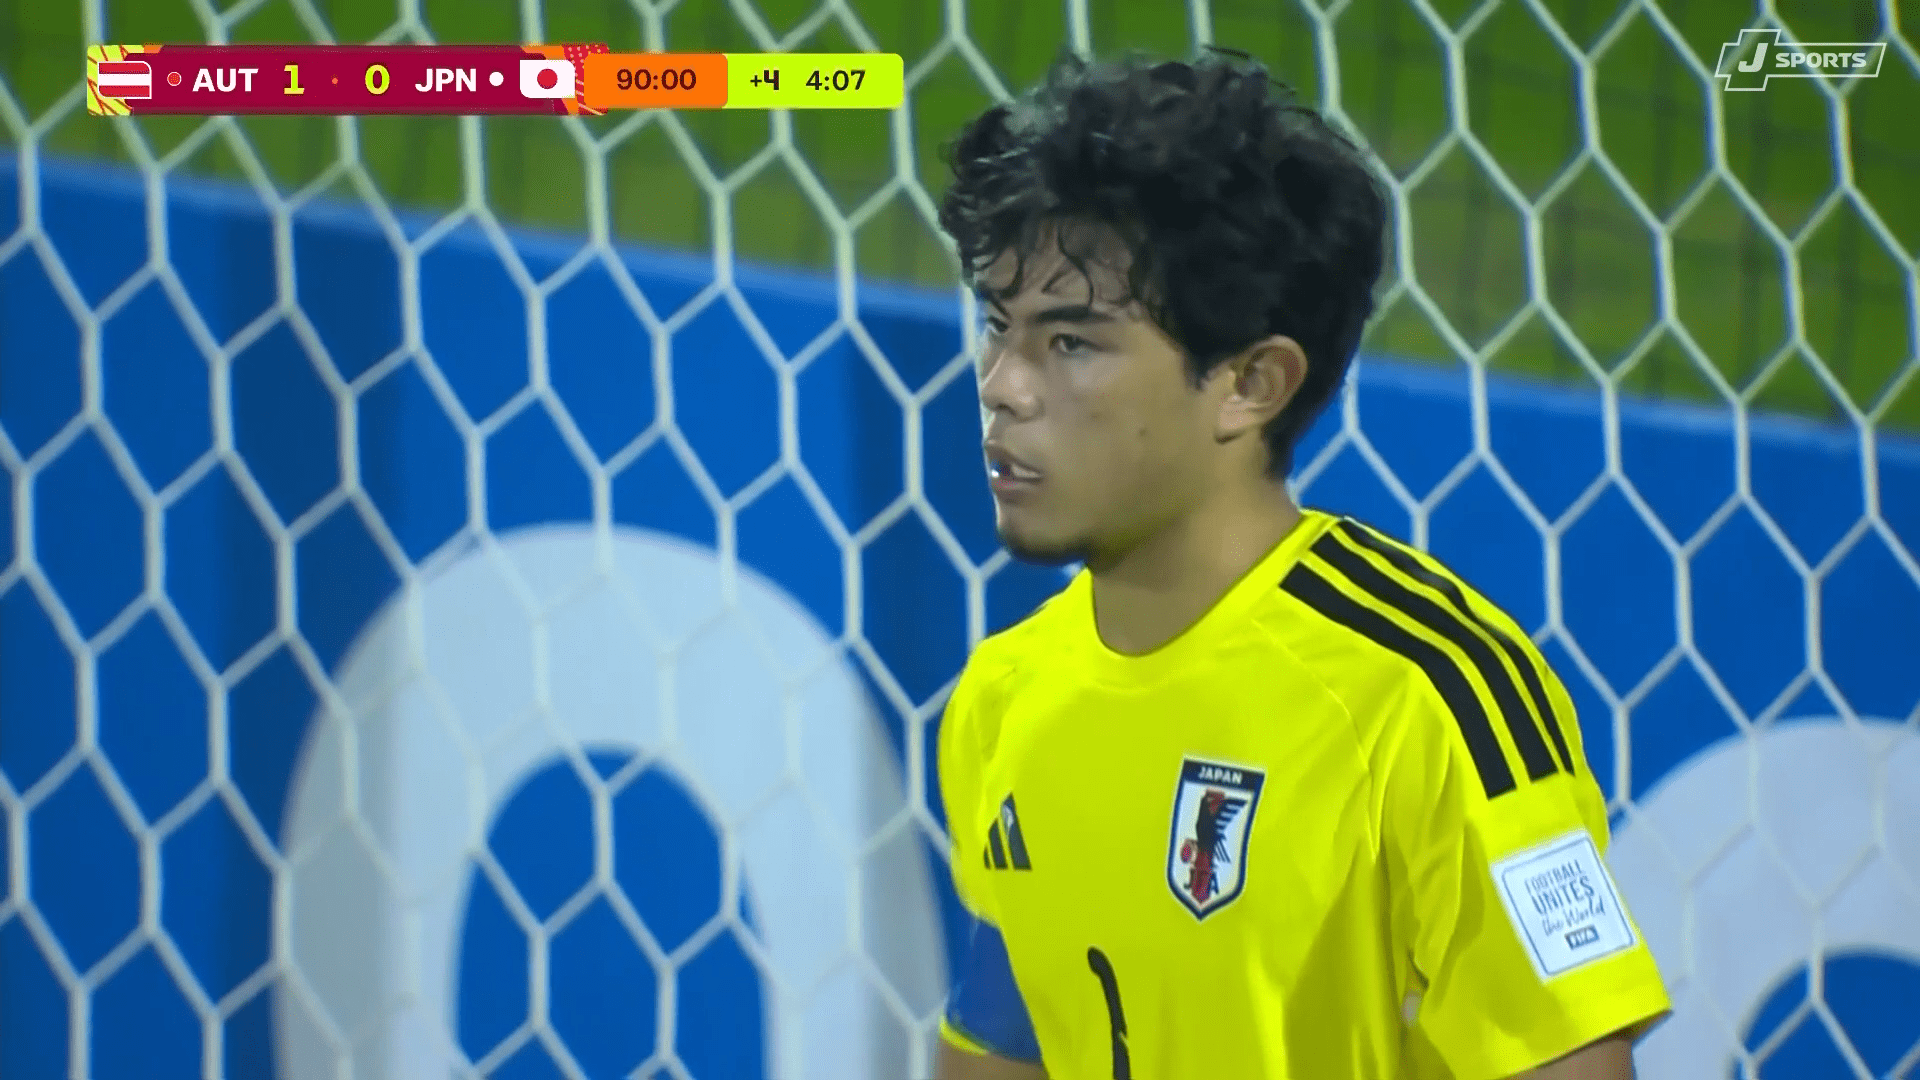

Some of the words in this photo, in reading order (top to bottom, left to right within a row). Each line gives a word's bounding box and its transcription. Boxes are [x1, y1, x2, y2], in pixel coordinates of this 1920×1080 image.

[1197, 766, 1243, 785] JAPAN
[1524, 859, 1582, 894] FOOTBALL
[1531, 875, 1595, 915] UNITES
[1563, 894, 1606, 927] World
